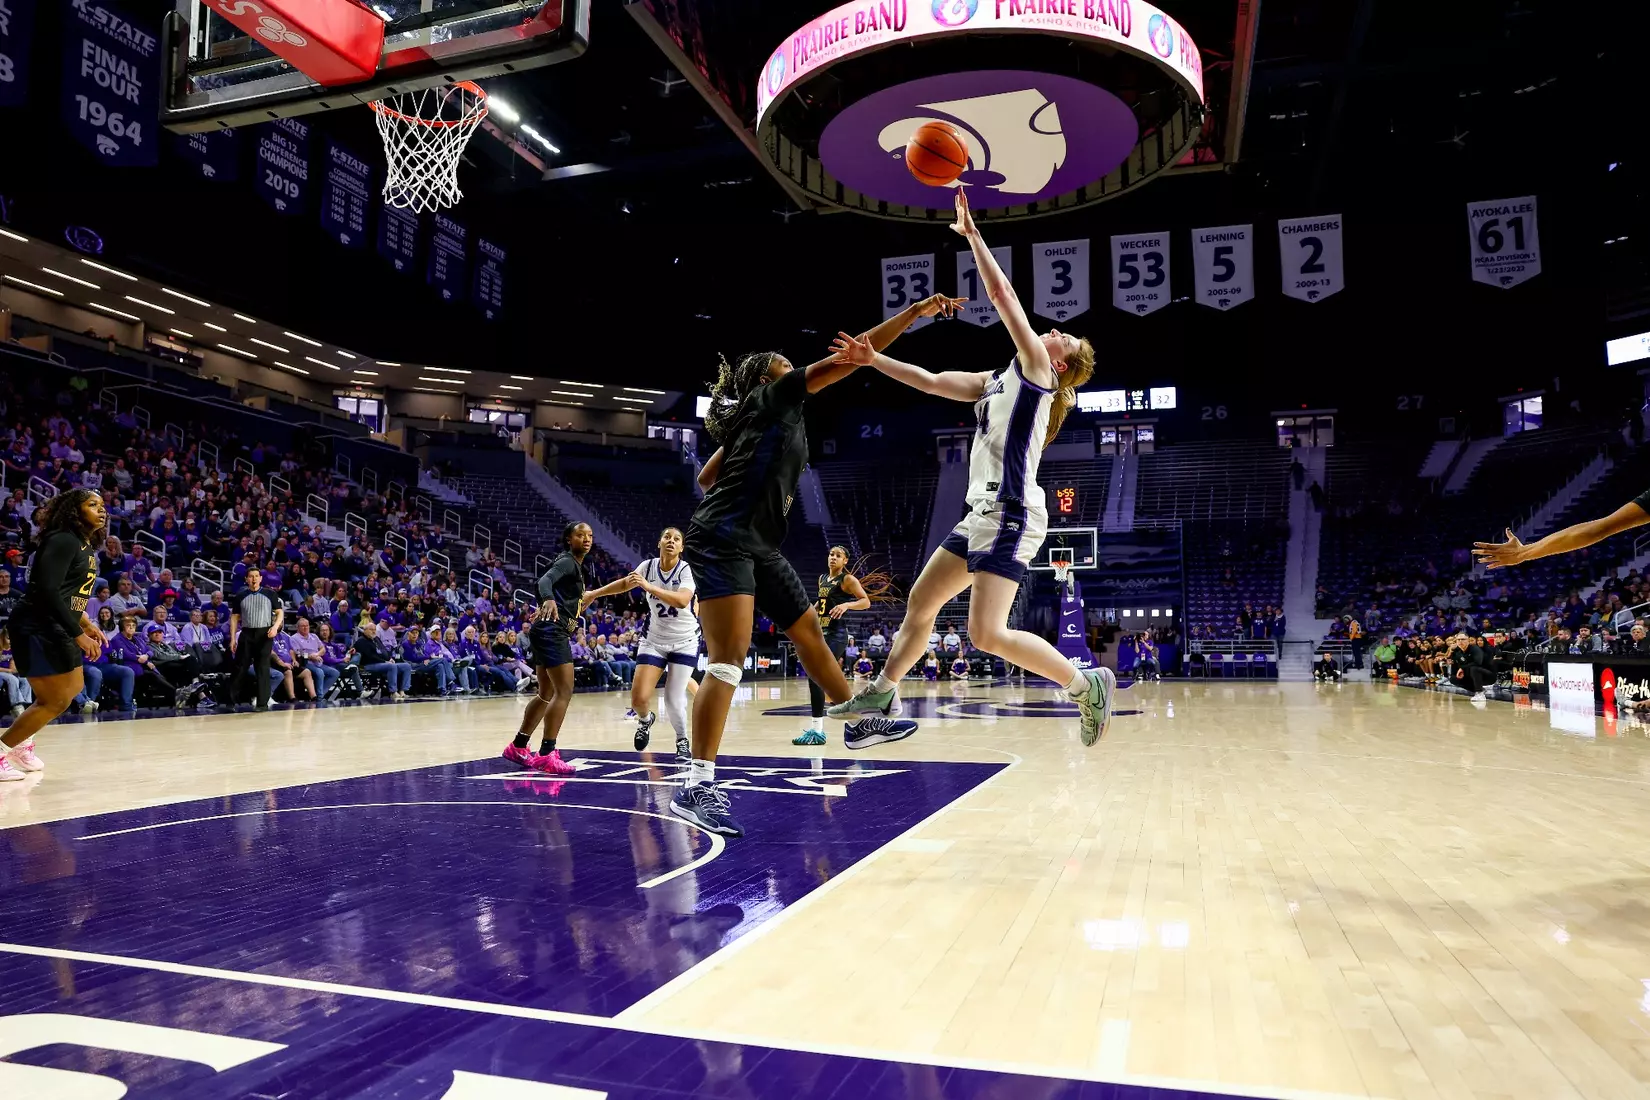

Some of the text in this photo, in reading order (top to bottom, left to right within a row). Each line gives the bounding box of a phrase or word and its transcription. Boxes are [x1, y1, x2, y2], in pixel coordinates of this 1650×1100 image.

[72, 0, 156, 52] K-STATE
[1084, 0, 1131, 38] BAND
[793, 0, 907, 73] PRAIRIE BAND
[82, 38, 142, 87] FINAL
[81, 58, 140, 106] FOUR
[75, 94, 142, 147] 1964
[188, 138, 207, 155] 2018
[260, 137, 308, 170] CONFERENCE
[272, 131, 298, 154] BIG 12
[259, 146, 309, 180] CHAMPIONS
[330, 145, 370, 176] K-STATE
[264, 169, 300, 199] 2019
[1472, 203, 1533, 218] AYOKA LEE
[434, 213, 467, 238] K-STATE
[1200, 231, 1245, 243] LEHNING
[1281, 221, 1340, 234] CHAMBERS
[1478, 216, 1525, 254] 61
[478, 237, 507, 260] K-STATE
[1044, 246, 1078, 257] OHLDE
[1120, 239, 1161, 249] WECKER
[1298, 236, 1325, 274] 2
[886, 260, 930, 271] ROMSTAD
[1212, 245, 1236, 282] 5
[1497, 252, 1530, 262] DIVISION
[1050, 259, 1073, 296] 3
[1118, 251, 1165, 289] 53
[886, 272, 930, 309] 33
[962, 268, 978, 301] 1
[1207, 287, 1242, 296] 2005-09
[1296, 279, 1331, 288] 2009-13
[1046, 300, 1078, 308] 2000-04
[1125, 293, 1159, 301] 2001-05
[1200, 405, 1228, 420] 26
[1396, 394, 1425, 410] 27
[860, 424, 884, 439] 24
[1056, 487, 1075, 498] 6:55
[1060, 498, 1073, 512] 12
[656, 603, 679, 618] 24
[1617, 676, 1640, 698] Pizza
